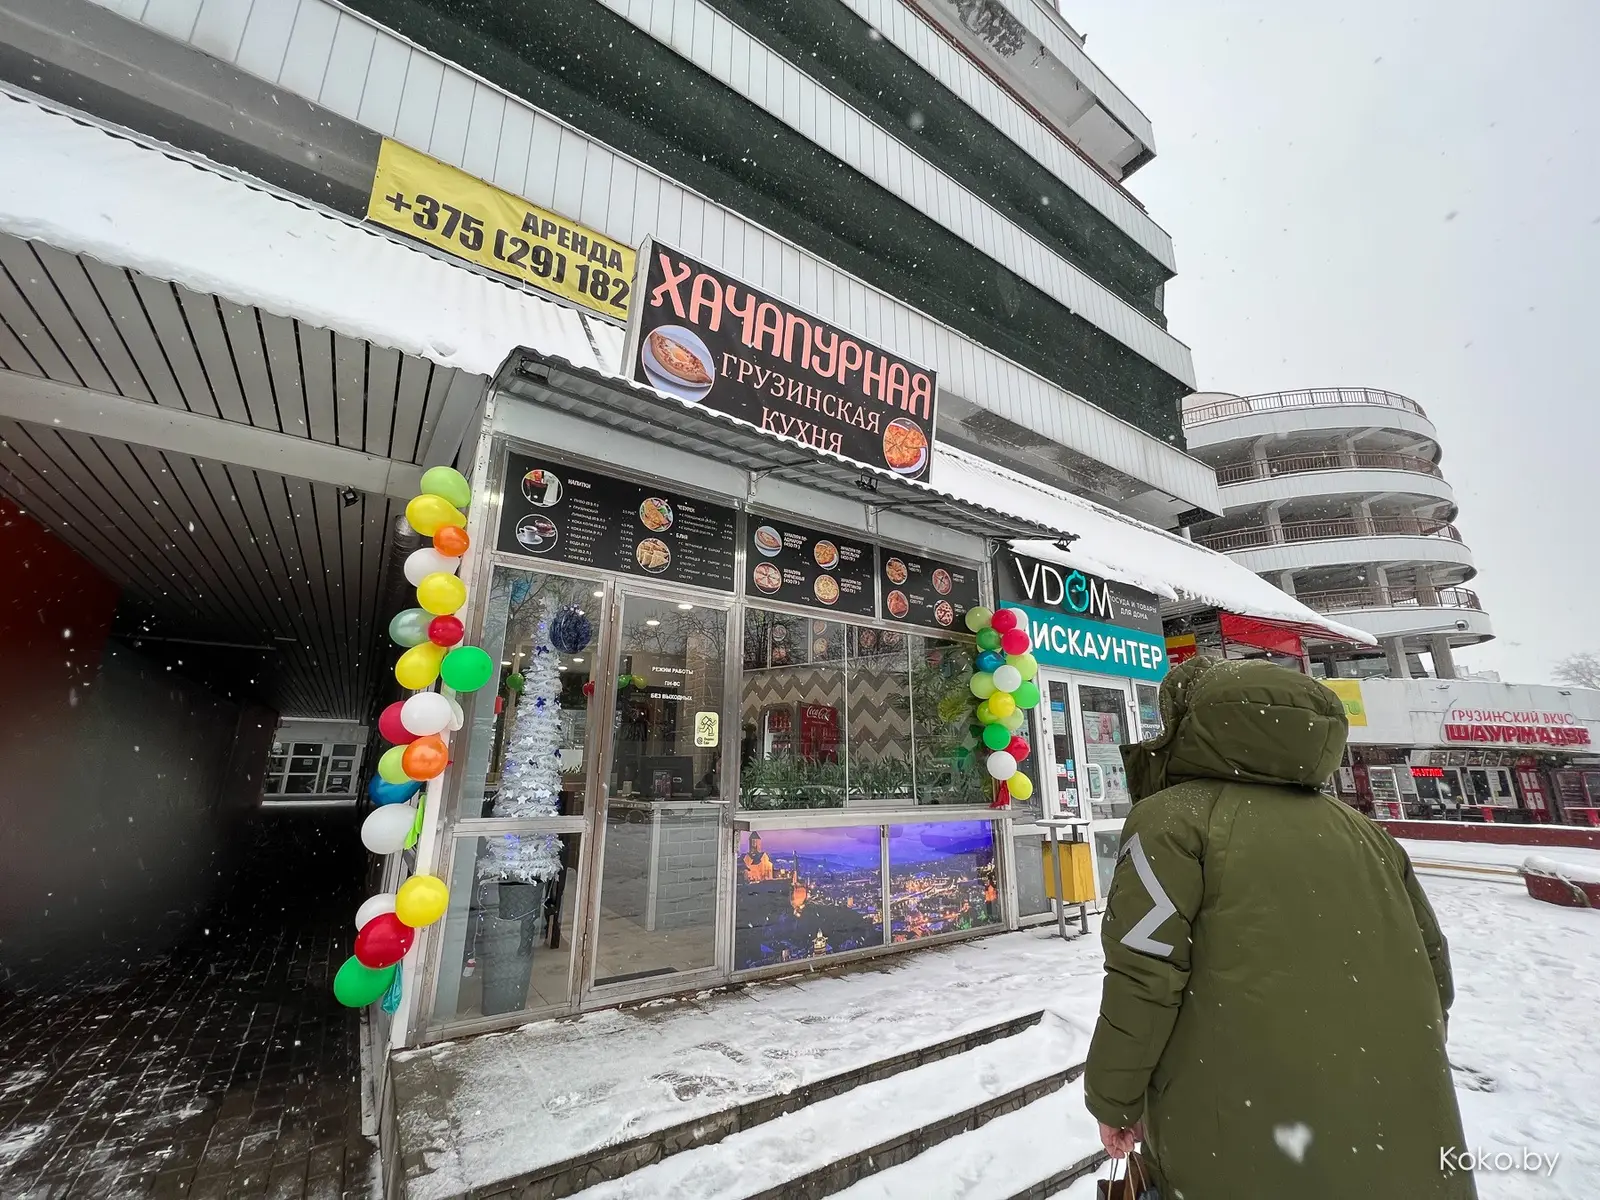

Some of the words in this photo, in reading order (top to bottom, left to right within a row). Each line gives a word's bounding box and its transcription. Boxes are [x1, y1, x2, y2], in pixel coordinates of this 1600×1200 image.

[385, 192, 484, 251] +375
[494, 229, 566, 284] (29)
[576, 264, 630, 310] 182
[521, 212, 623, 272] АРЕНДА
[650, 253, 931, 420] ХАЧАПУРНАЯ
[720, 352, 881, 434] ГРУЗИНСКАЯ
[761, 407, 843, 455] КУХНЯ
[1120, 608, 1132, 616] ДЛЯ
[1132, 611, 1148, 620] ДОМА
[1136, 602, 1157, 613] ТОВАРЫ
[1028, 620, 1163, 670] ИСКАУНТЕР
[1444, 724, 1592, 746] ШАУРМАДЗЕ
[1452, 709, 1540, 724] ГРУЗИНСКИЙ
[1543, 712, 1574, 725] ВКУС
